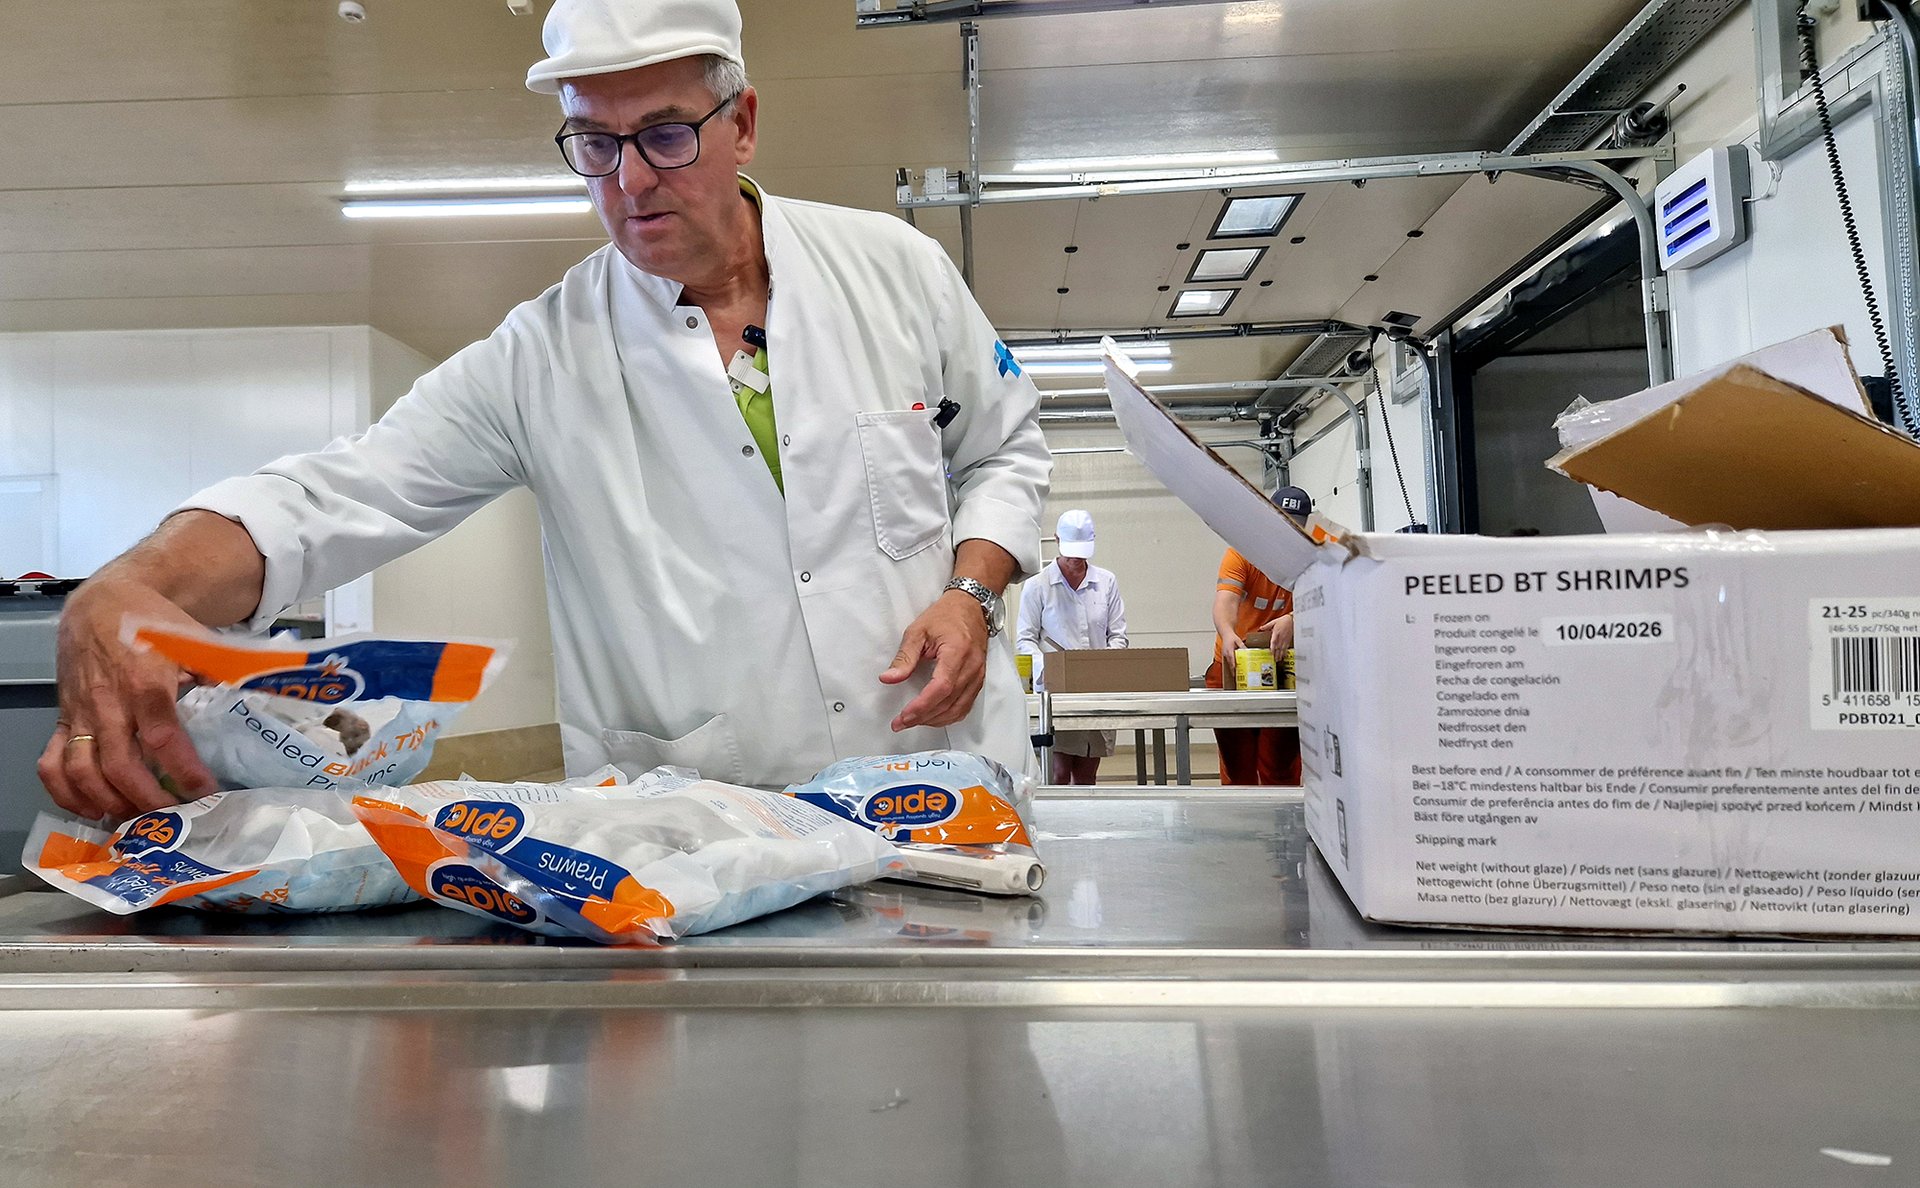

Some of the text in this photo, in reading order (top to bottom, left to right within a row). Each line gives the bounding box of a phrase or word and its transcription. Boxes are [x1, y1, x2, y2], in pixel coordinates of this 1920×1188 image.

[1282, 497, 1301, 511] FBI
[1406, 567, 1689, 595] PEELED BT SHRIMPS
[1434, 613, 1472, 623] Frozen
[1823, 606, 1867, 618] 21-25
[1434, 627, 1538, 639] Produit congelé le
[1557, 622, 1661, 640] 10/04/2026
[1435, 645, 1516, 656] Ingevroren op
[1436, 659, 1524, 672] Eingefroren am
[1436, 675, 1560, 687] Fecha de congelación
[1436, 691, 1498, 703] Congelado
[1822, 694, 1830, 706] 5
[1504, 707, 1530, 716] dnia
[1438, 722, 1526, 732] Nedfrosset den
[229, 699, 324, 769] Peeled
[1439, 738, 1513, 749] Nedfryst den
[1412, 765, 1436, 774] Best
[1439, 765, 1477, 775] before
[1480, 766, 1502, 775] end
[1514, 767, 1522, 775] A
[1525, 768, 1595, 776] consommer
[1599, 767, 1614, 777] de
[1618, 767, 1684, 778] préférence
[1725, 767, 1742, 777] fin
[1754, 767, 1777, 778] Ten
[1781, 768, 1823, 778] minste
[1827, 768, 1888, 778] houdbaar
[1892, 768, 1910, 777] tot
[1413, 780, 1430, 790] Bei
[1470, 782, 1537, 792] mindestens
[1540, 782, 1582, 792] haltbar
[1586, 783, 1602, 792] bis
[1606, 783, 1636, 793] Ende
[1649, 783, 1708, 793] Consumir
[1712, 784, 1819, 795] preferentemente
[1823, 786, 1857, 795] antes
[1861, 784, 1880, 795] del
[1885, 784, 1900, 794] fin
[1905, 784, 1919, 794] de
[873, 789, 949, 817] epic
[1413, 796, 1467, 806] Consumir
[1470, 797, 1485, 807] de
[1489, 798, 1554, 809] preferência
[1558, 800, 1589, 809] antes
[1593, 799, 1609, 809] do
[1612, 799, 1632, 809] fim
[1635, 799, 1650, 809] de
[1664, 800, 1717, 812] Najlepiej
[1767, 801, 1802, 812] przed
[1806, 801, 1855, 811] końcem
[1870, 801, 1912, 811] Mindst
[445, 802, 518, 840] epic
[1414, 812, 1538, 825] Bäst före utgången av
[1416, 834, 1496, 847] Shipping mark
[538, 851, 609, 891] Prawns
[1416, 861, 1435, 871] Net
[1439, 862, 1477, 873] weight
[1481, 863, 1529, 874] (without
[1534, 864, 1567, 875] glaze)
[1580, 865, 1611, 875] Poids
[1615, 867, 1634, 875] net
[1638, 866, 1669, 877] (sans
[1672, 866, 1721, 878] glazure)
[1735, 868, 1819, 881] Nettogewicht
[1824, 870, 1871, 882] (zonder
[1417, 877, 1492, 888] Nettogewicht
[1497, 879, 1529, 889] (ohne
[1533, 878, 1626, 892] Überzugsmittel)
[1640, 882, 1668, 892] Peso
[1672, 884, 1699, 893] neto
[1703, 883, 1725, 895] (sin
[1728, 884, 1740, 894] el
[1743, 885, 1803, 897] glaseado)
[1817, 887, 1846, 896] Peso
[1851, 887, 1893, 898] líquido
[441, 883, 529, 918] epic
[1418, 893, 1447, 902] Masa
[1451, 895, 1481, 903] netto
[1485, 894, 1508, 905] (bez
[1512, 895, 1556, 907] glazury)
[1570, 897, 1631, 909] Nettovægt
[1636, 898, 1673, 908] (ekskl.
[1677, 899, 1736, 912] glasering)
[1751, 901, 1807, 911] Nettovikt
[1812, 902, 1844, 913] (utan
[1849, 904, 1909, 915] glasering)
